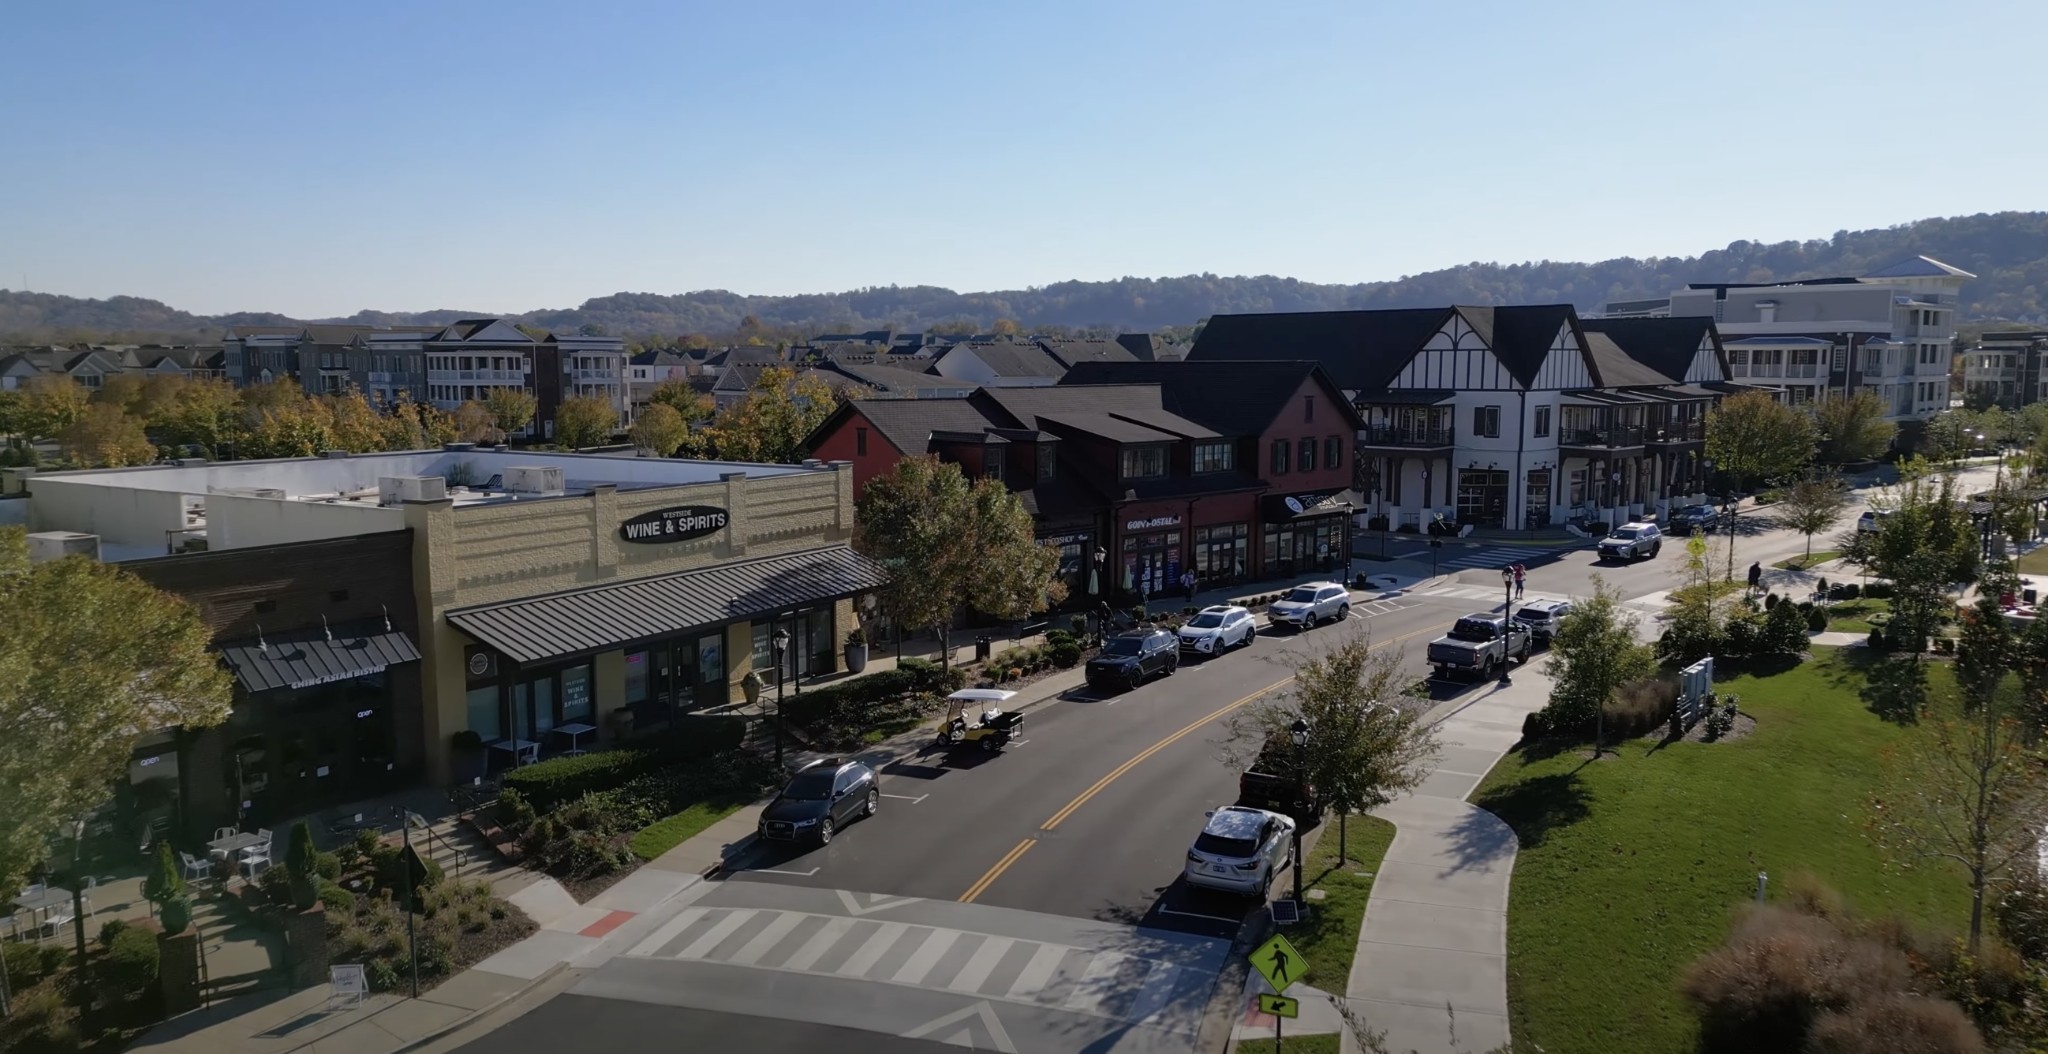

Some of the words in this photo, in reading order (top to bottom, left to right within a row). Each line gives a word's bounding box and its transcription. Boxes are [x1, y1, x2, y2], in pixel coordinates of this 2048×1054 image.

[662, 509, 692, 519] WESTSIDE
[626, 521, 661, 539] WINE
[665, 519, 674, 534] &
[678, 513, 725, 532] SPIRITS
[291, 677, 322, 689] CHING
[323, 671, 353, 683] ASIAN
[567, 686, 583, 694] WINE
[564, 696, 589, 708] SPIRITS
